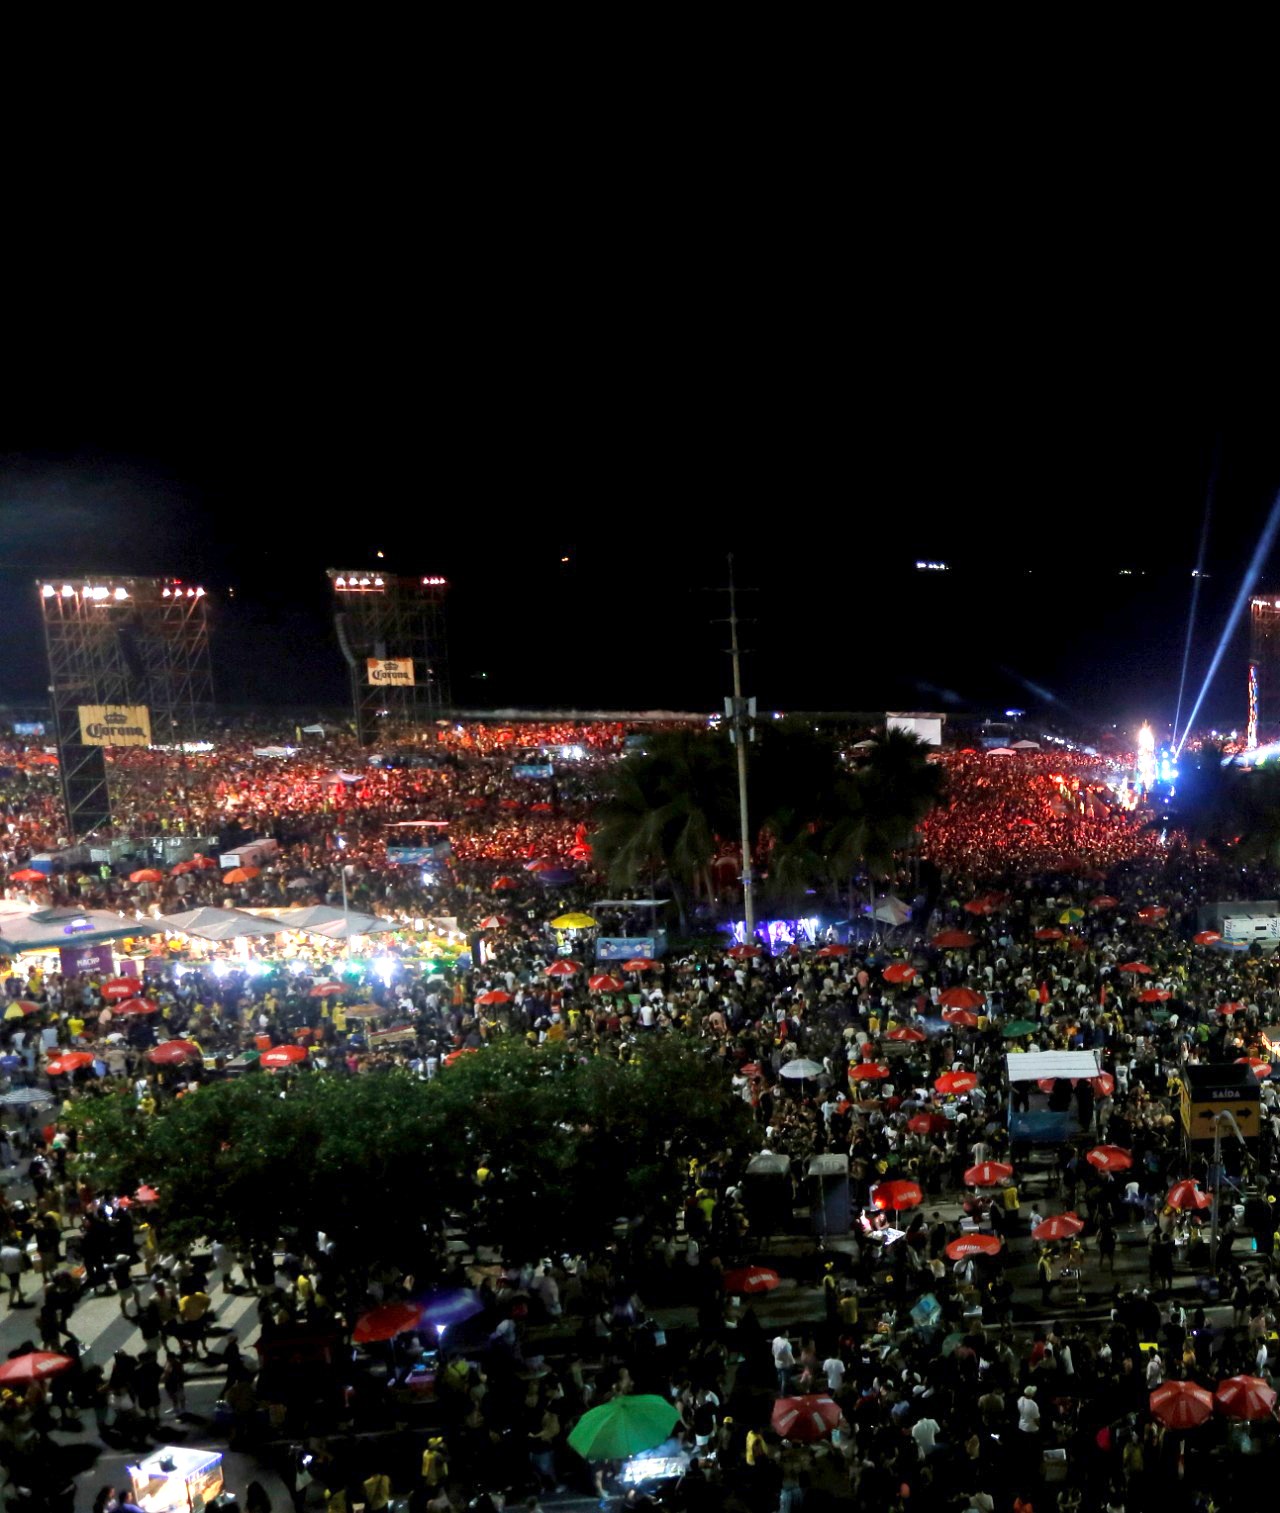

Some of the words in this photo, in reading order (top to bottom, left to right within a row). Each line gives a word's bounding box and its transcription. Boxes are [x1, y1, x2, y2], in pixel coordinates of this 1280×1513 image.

[372, 670, 411, 681] Corona
[86, 723, 147, 739] Corona
[1212, 1089, 1241, 1099] SAÍDA
